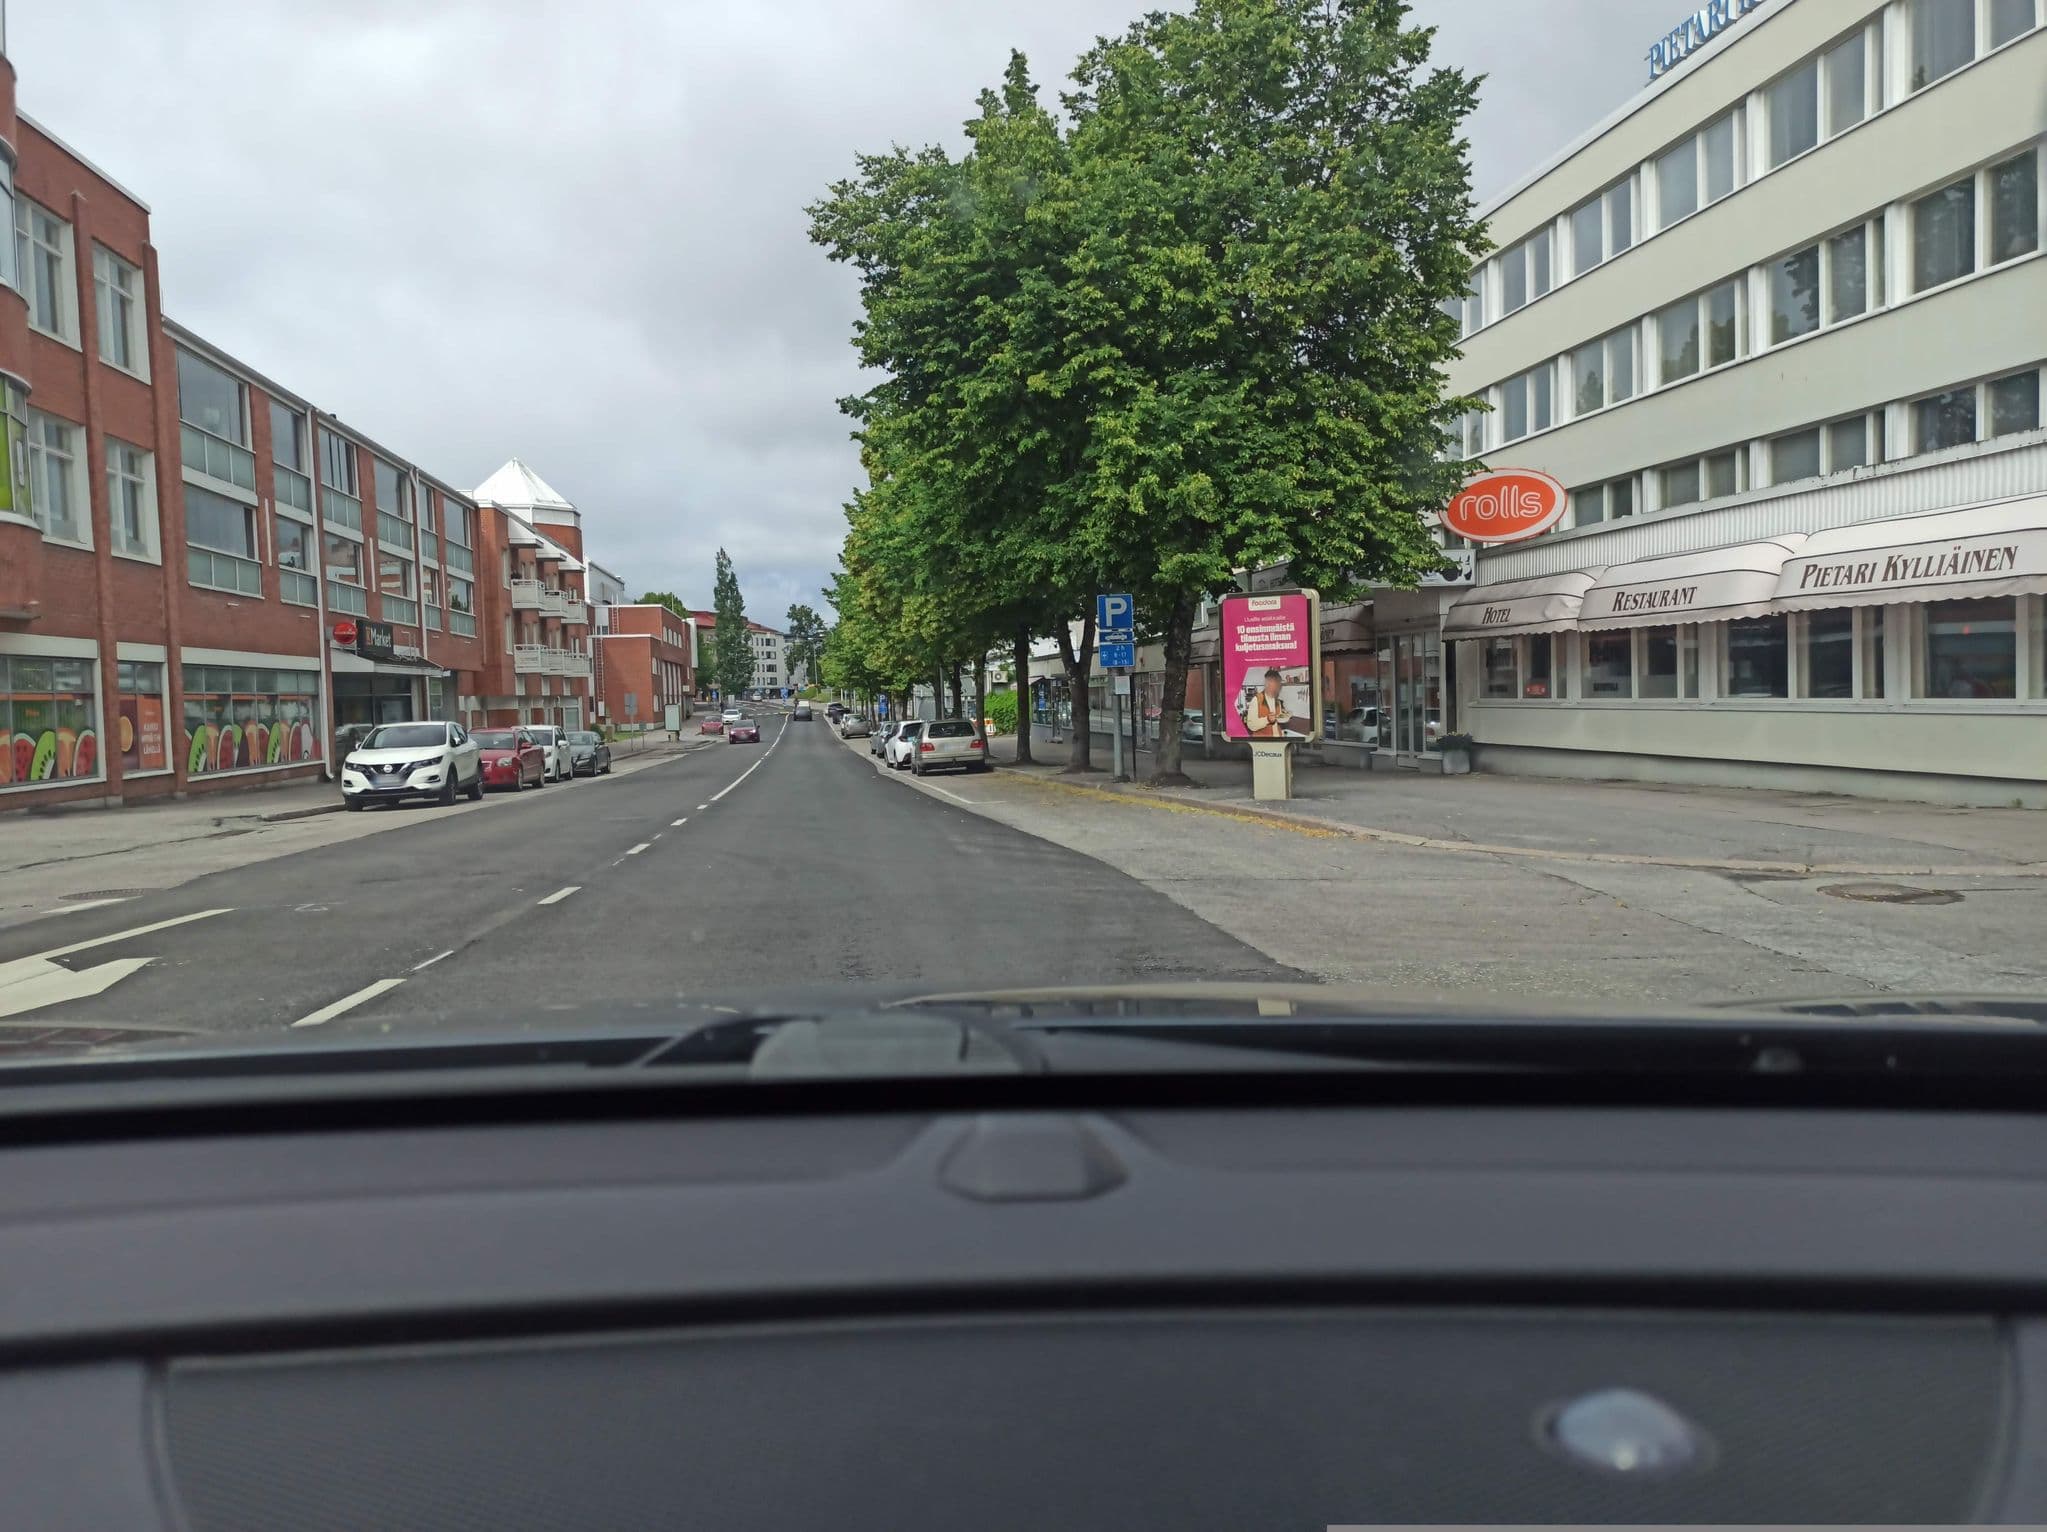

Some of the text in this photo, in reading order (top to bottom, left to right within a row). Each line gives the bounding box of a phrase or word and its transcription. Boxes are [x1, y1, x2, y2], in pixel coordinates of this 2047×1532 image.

[1650, 0, 1734, 79] PIETARI
[1459, 484, 1543, 521] rolls
[1799, 544, 2019, 589] PIETARI KYLLIÄINEN
[1105, 597, 1128, 627] P
[1611, 585, 1698, 612] RESTAURANT
[1237, 625, 1245, 634] 10
[1481, 605, 1512, 625] HOTEL
